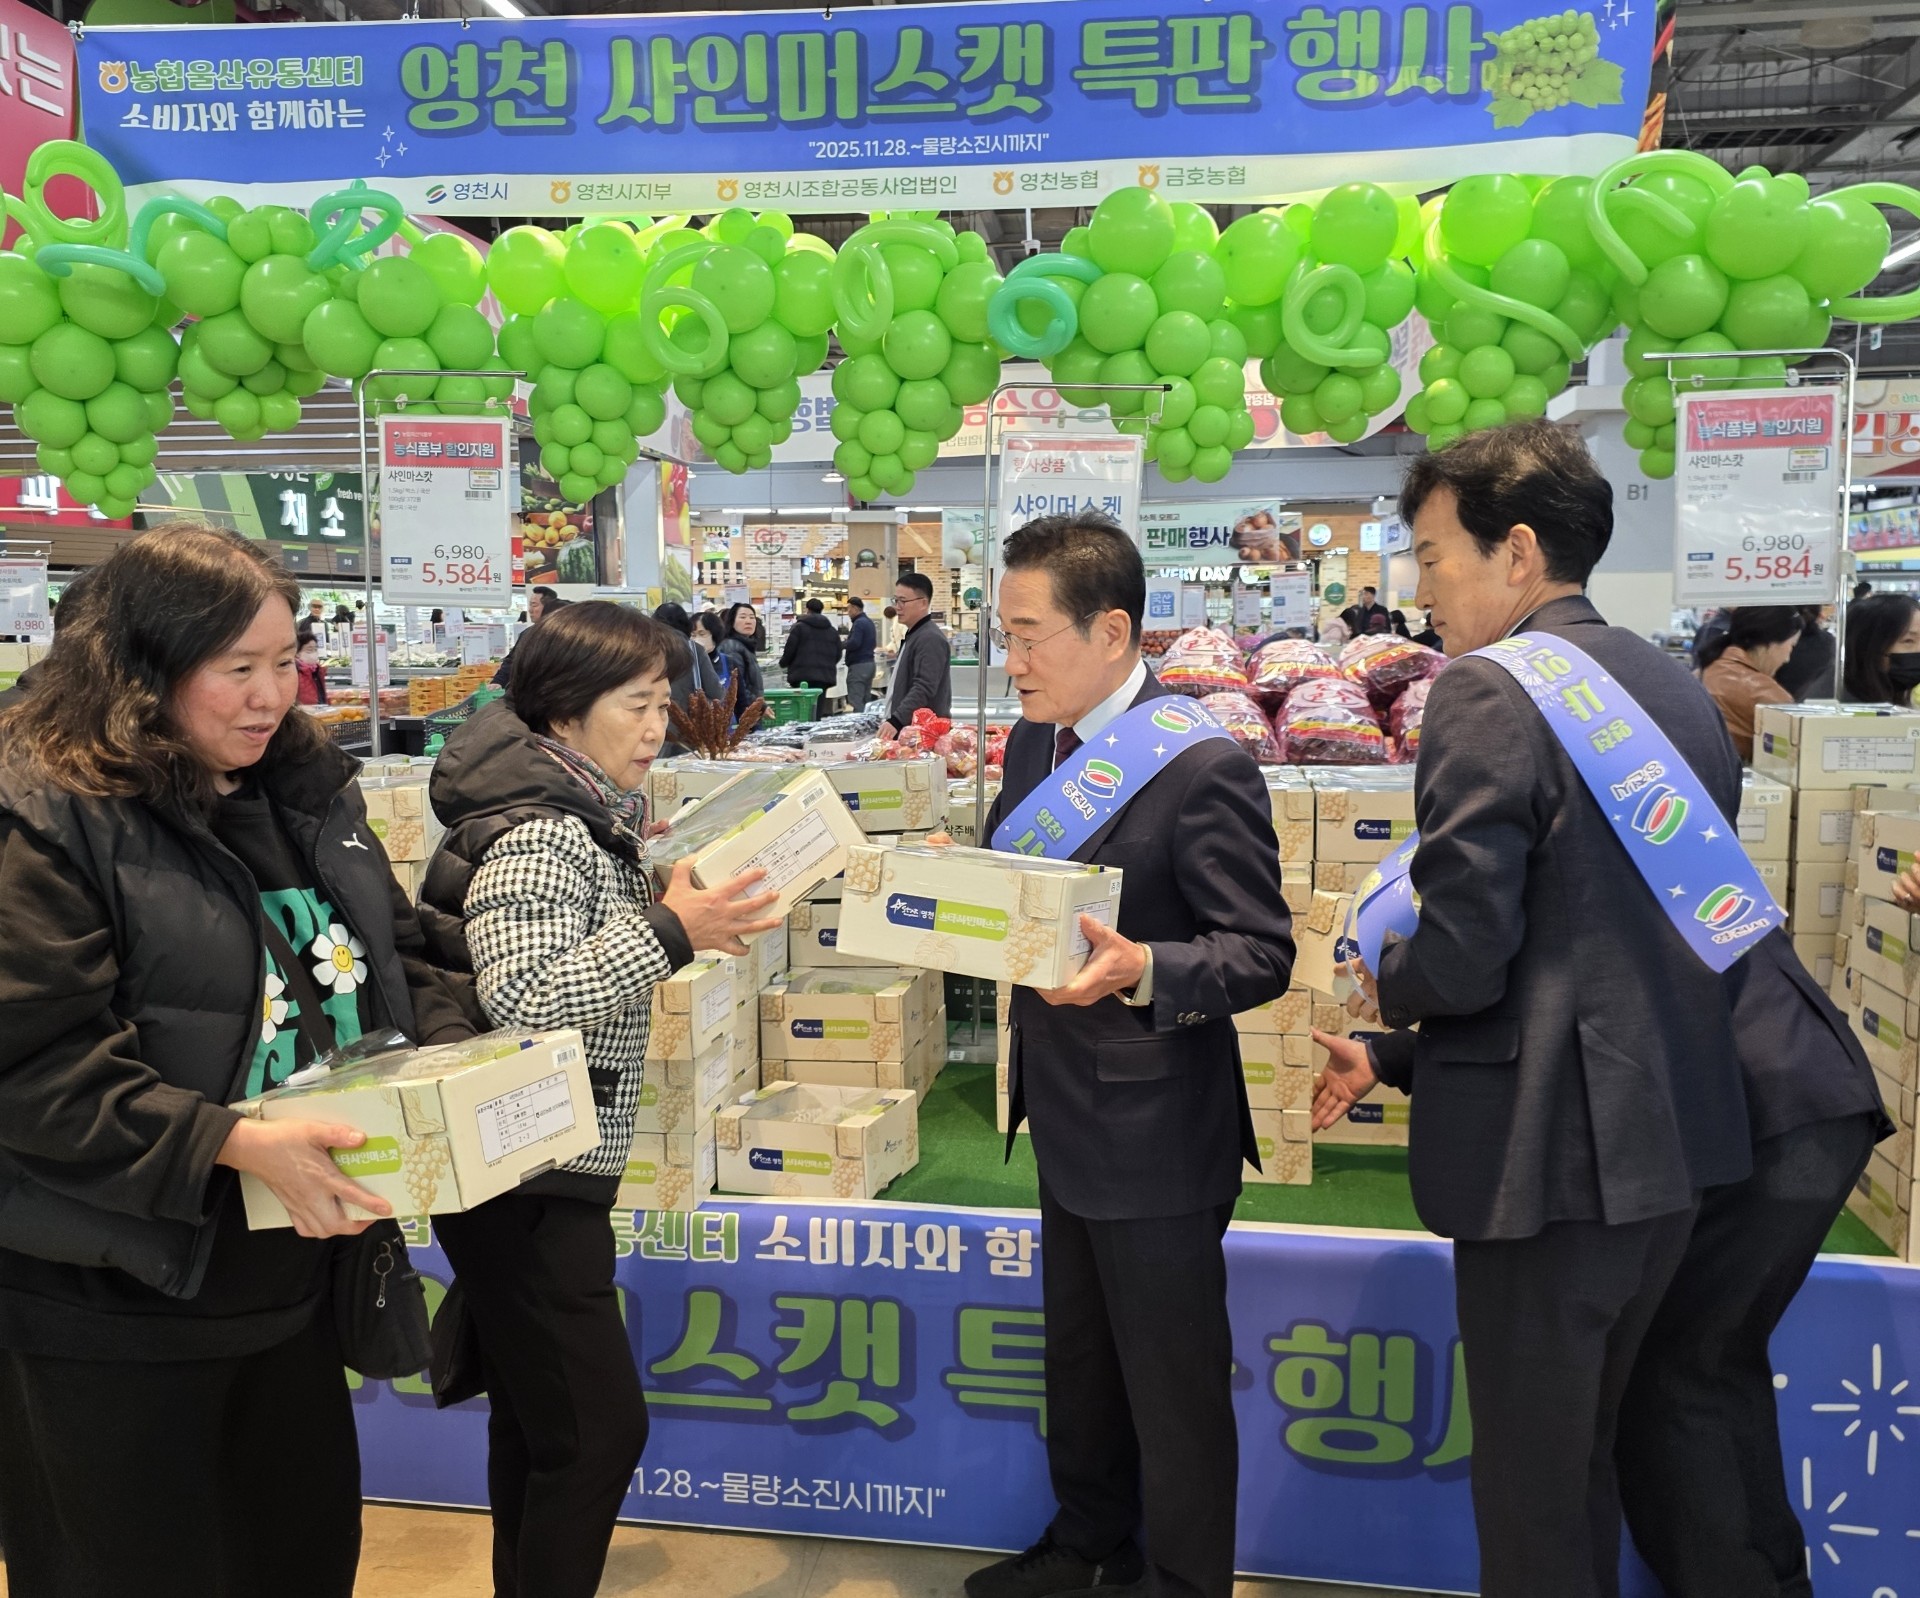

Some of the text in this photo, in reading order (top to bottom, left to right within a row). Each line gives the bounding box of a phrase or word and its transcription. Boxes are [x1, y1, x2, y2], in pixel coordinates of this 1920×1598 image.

[130, 56, 363, 94] 농협울산유통센터
[401, 4, 1486, 130] 영천 샤인머스캣 특판 행사
[120, 99, 366, 132] 소비자와 함께하는
[808, 132, 1050, 159] "2025.11.28.~물량소진시까지"
[1020, 171, 1099, 192] 영천농협
[1166, 165, 1247, 187] 금호농협
[453, 181, 509, 201] 영천시
[576, 183, 672, 200] 영천시지부
[744, 175, 958, 199] 영천시조합공동사업법인
[394, 442, 494, 457] 농식품부 할인지원
[1013, 457, 1065, 473] 행사상품
[388, 470, 433, 482] 샤인마스캇
[1627, 485, 1648, 500] B1
[279, 489, 346, 536] 채소
[1147, 525, 1230, 549] 판매행사
[1742, 535, 1804, 552] 6,980
[434, 545, 484, 560] 6,980
[422, 563, 501, 586] 5,584 원
[1200, 566, 1233, 582] DAY
[1725, 555, 1812, 583] 5,584
[1813, 564, 1823, 575] 원
[1152, 592, 1173, 604] 국산
[1152, 605, 1173, 615] 대표
[1062, 779, 1097, 821] 영천시
[944, 825, 974, 836] 상주배
[1034, 807, 1066, 843] 영천
[920, 910, 934, 920] 영천
[755, 1216, 968, 1273] 소비자와
[985, 1227, 1040, 1278] 함
[643, 1290, 900, 1427] 스캣
